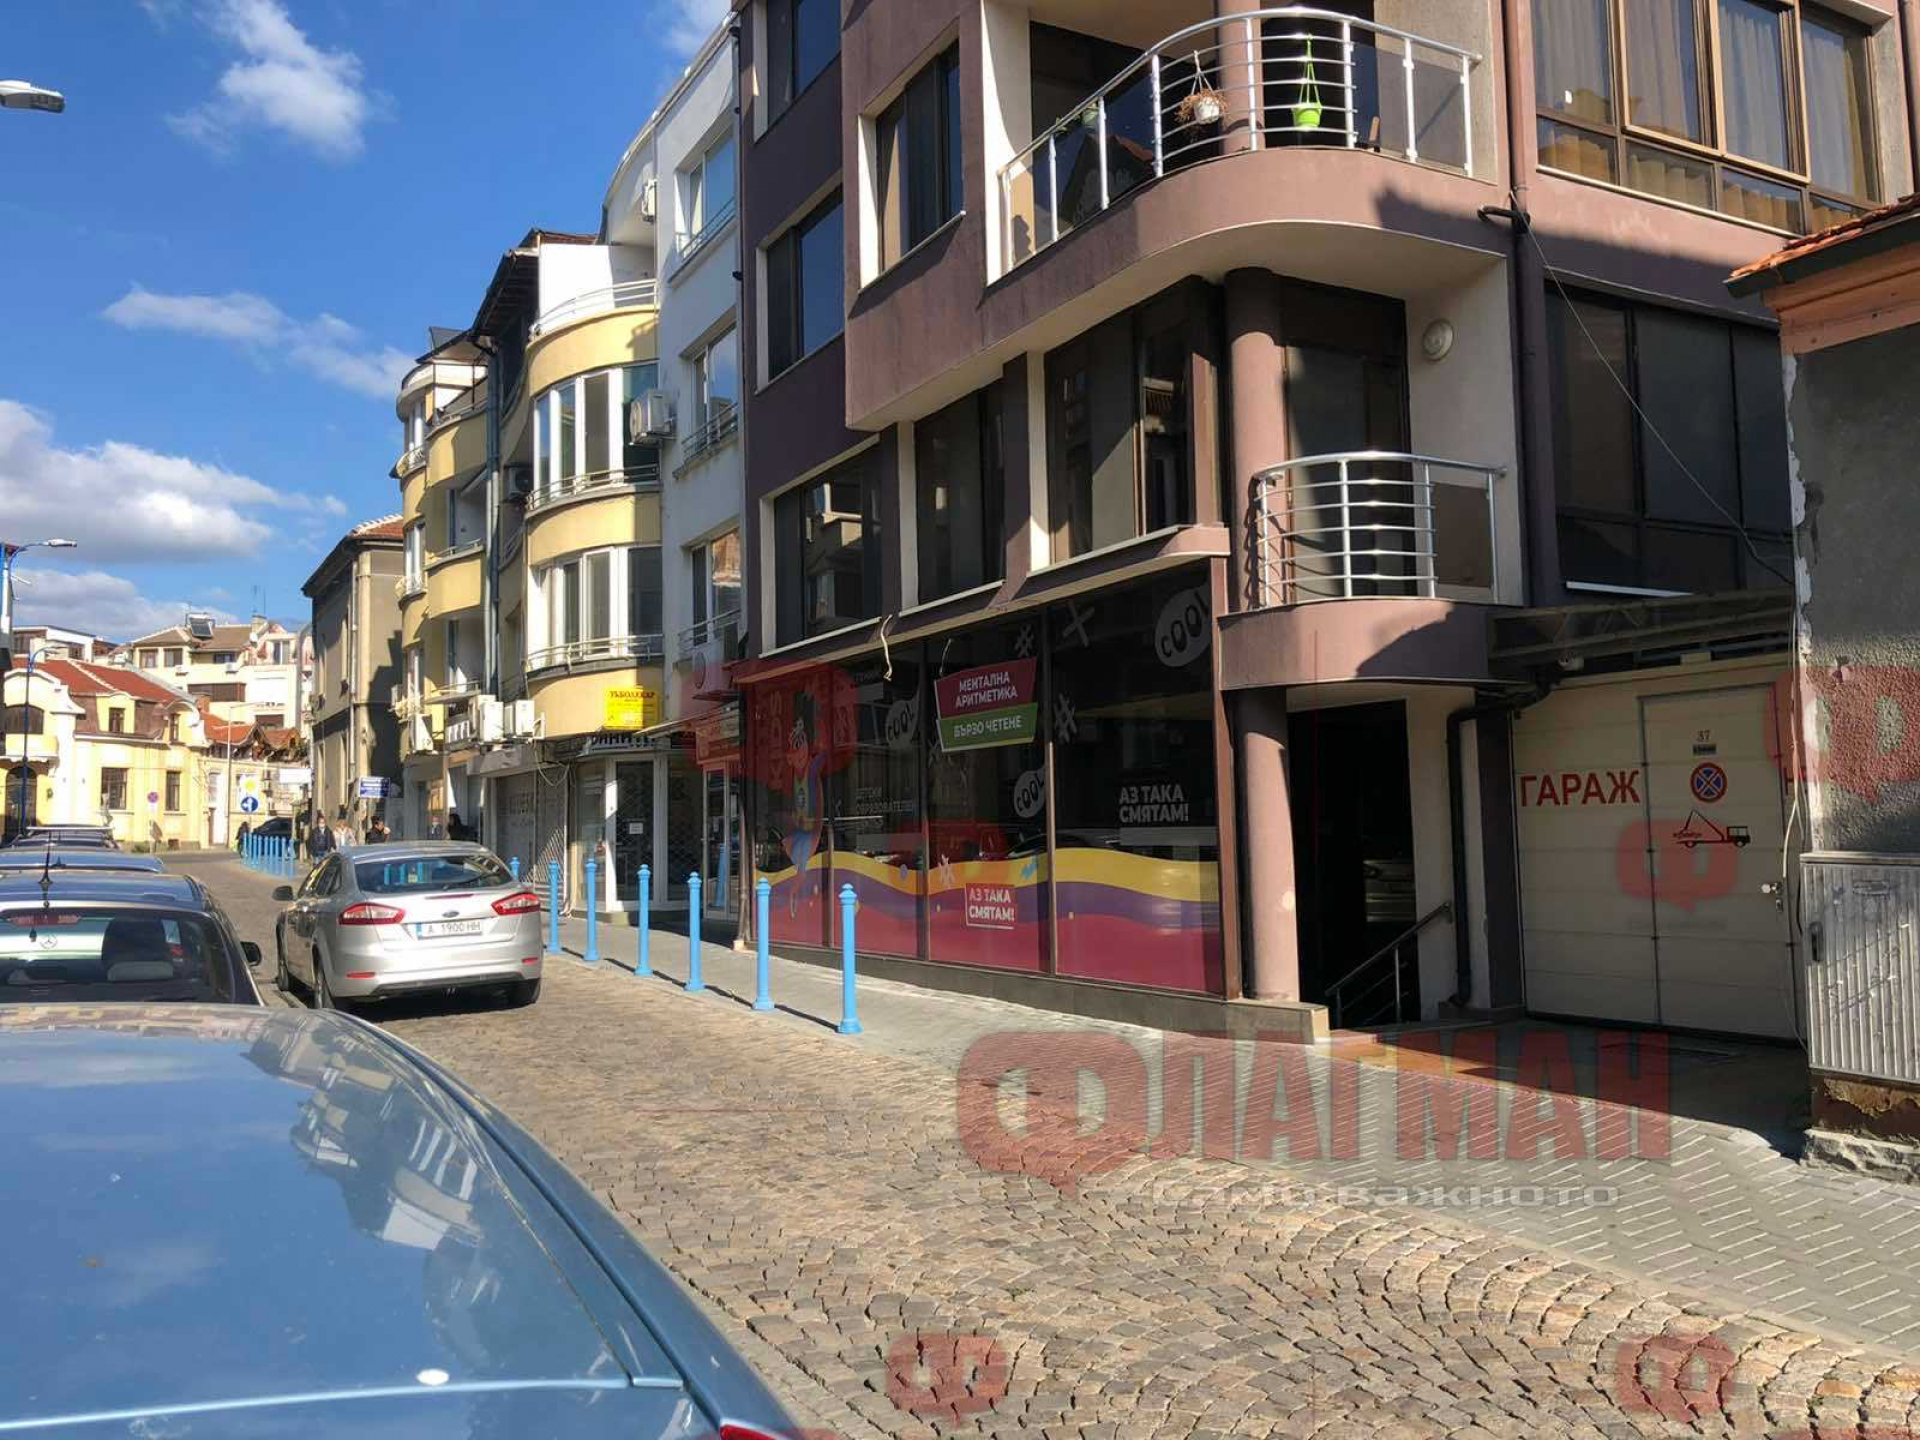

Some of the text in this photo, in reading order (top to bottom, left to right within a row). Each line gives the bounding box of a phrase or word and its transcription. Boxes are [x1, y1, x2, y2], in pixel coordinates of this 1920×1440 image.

[959, 671, 1010, 692] МЕНТАЛНА
[955, 686, 1018, 709] АРИТМЕТИКА
[953, 715, 1023, 738] БЪРЗО ЧЕТЕНЕ
[1119, 784, 1185, 804] АЗ ТАКА
[1519, 769, 1640, 807] ГАРАЖ
[1119, 803, 1189, 823] СМЯТАМ!
[969, 887, 1012, 903] АЗ ТАКА
[968, 905, 1015, 923] СМЯТАМ!
